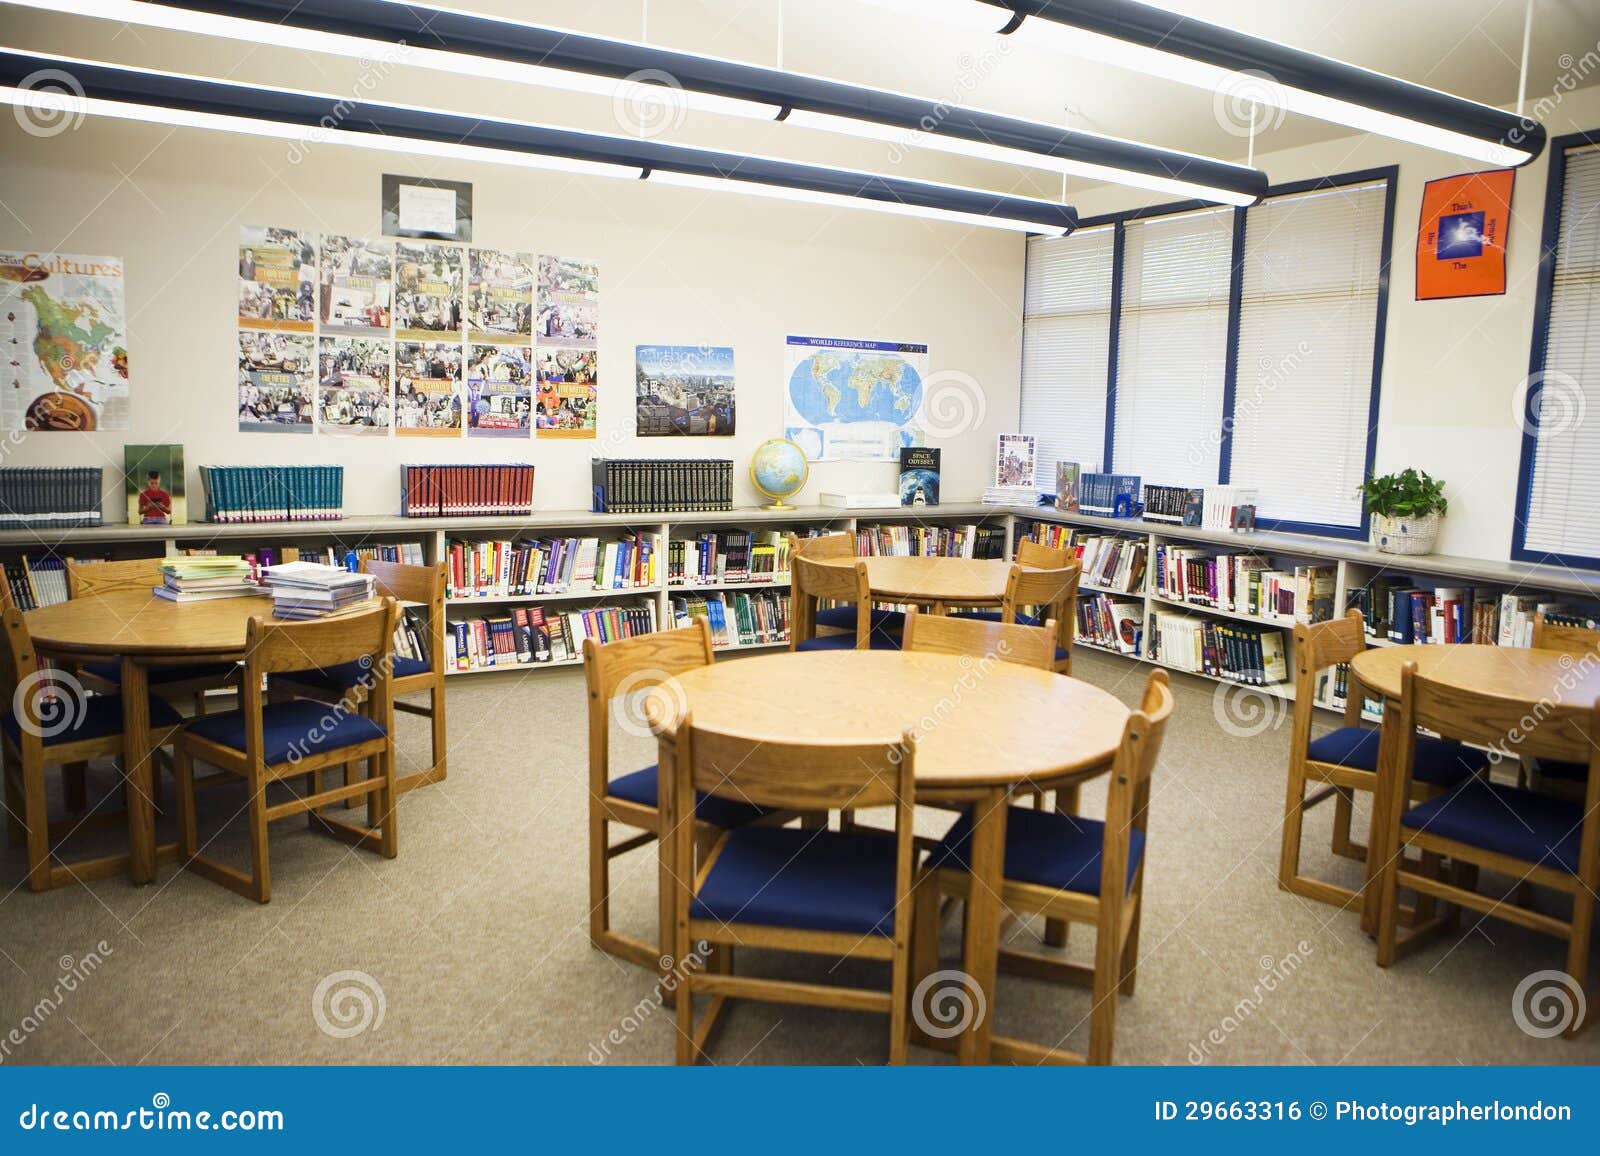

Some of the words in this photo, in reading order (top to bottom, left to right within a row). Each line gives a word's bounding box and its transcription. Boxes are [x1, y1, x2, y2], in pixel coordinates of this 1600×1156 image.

[23, 254, 121, 277] Cultures
[1452, 261, 1467, 270] The
[809, 338, 833, 346] WORLD
[833, 340, 864, 349] REFERENCE
